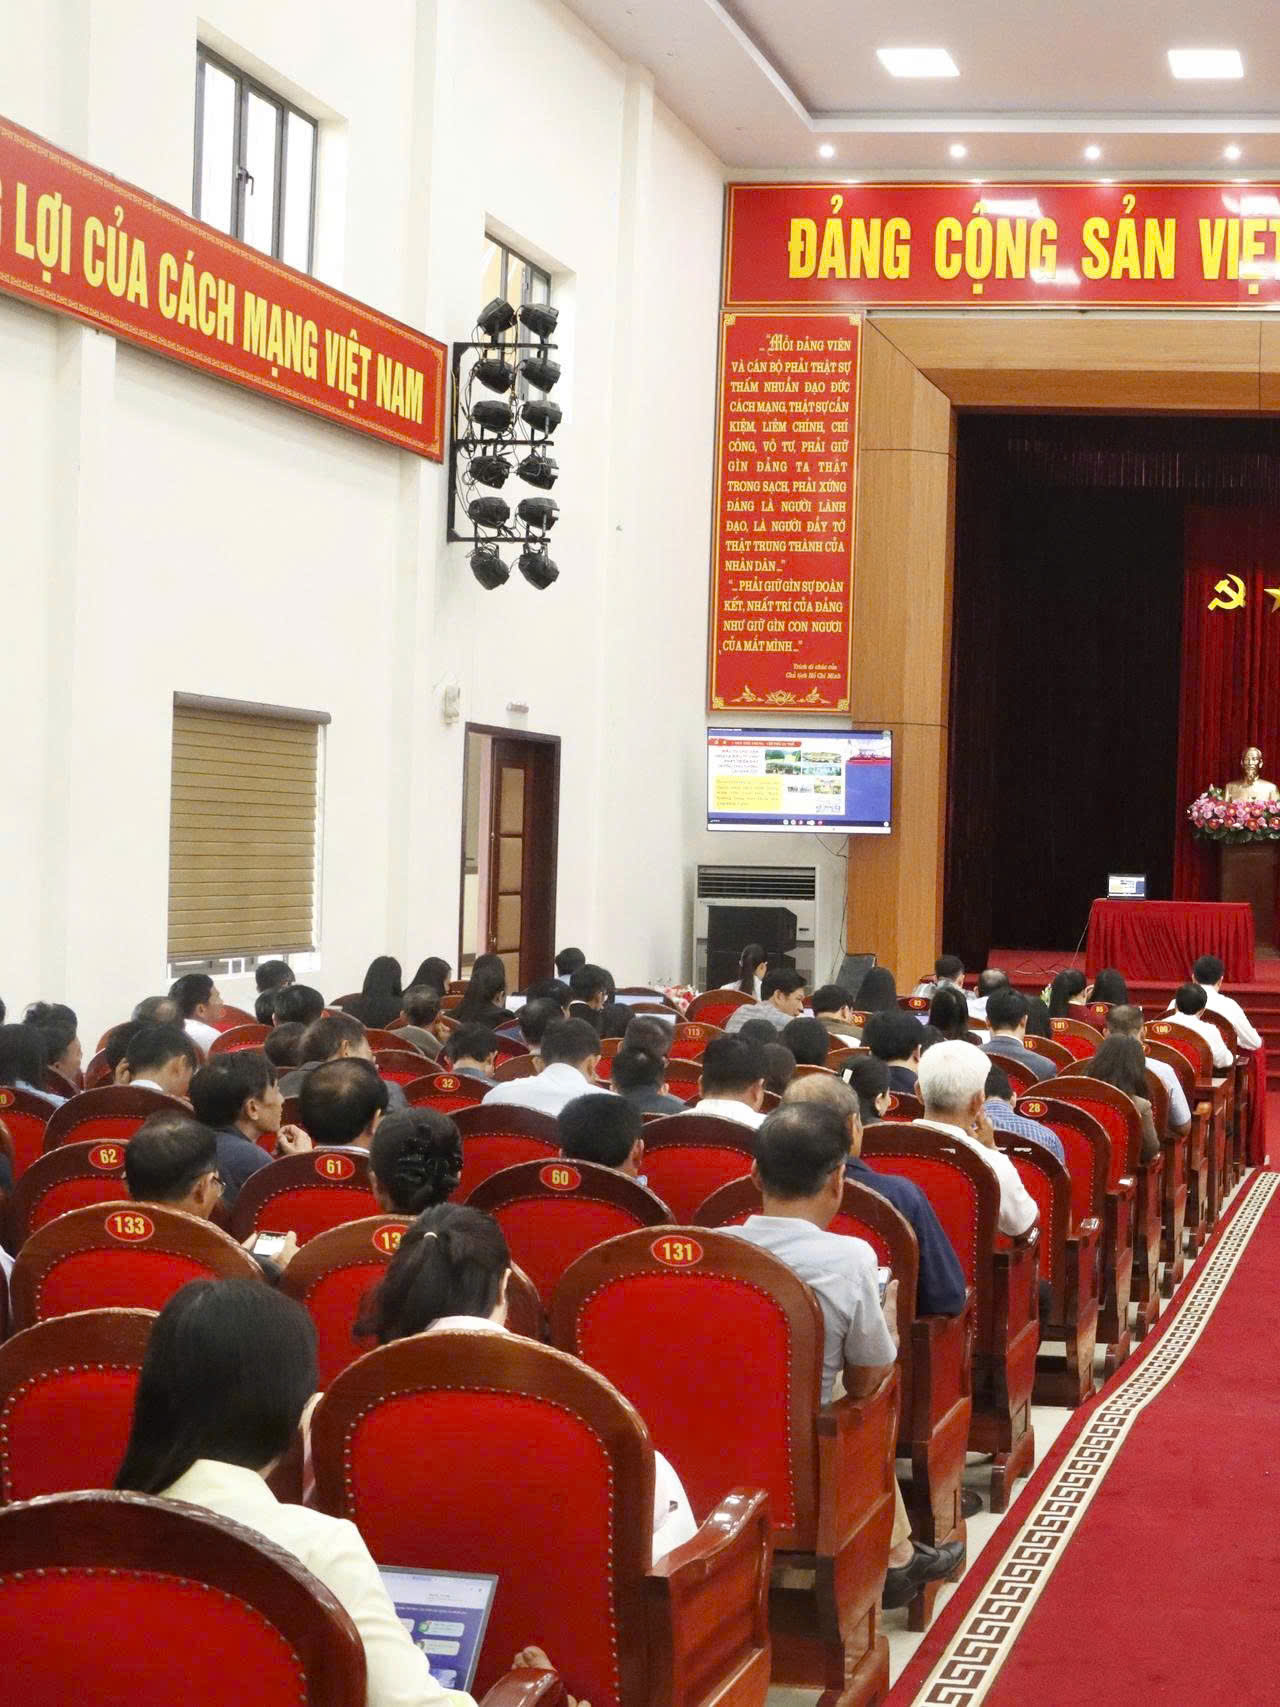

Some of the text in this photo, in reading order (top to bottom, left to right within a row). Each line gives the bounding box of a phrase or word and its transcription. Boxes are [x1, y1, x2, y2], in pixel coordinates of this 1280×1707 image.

[788, 194, 911, 280] ĐẢNG
[935, 203, 1058, 294] CỘNG
[1081, 194, 1177, 280] SẢN
[15, 183, 72, 284] LỢI
[83, 205, 148, 309] CỦA
[159, 250, 235, 344] CÁCH
[243, 291, 318, 377] MẠNG
[325, 328, 372, 409] VIỆT
[376, 353, 424, 424] NAM
[796, 462, 810, 472] TA
[727, 481, 760, 491] TRONG
[753, 541, 786, 552] TRUNG
[788, 621, 808, 632] CON
[442, 1079, 453, 1088] 32
[1028, 1103, 1040, 1113] 28
[100, 1149, 117, 1164] 62
[327, 1159, 342, 1174] 61
[552, 1170, 569, 1185] 60
[114, 1216, 145, 1234] 133
[381, 1231, 401, 1250] 13
[662, 1243, 692, 1261] 131
